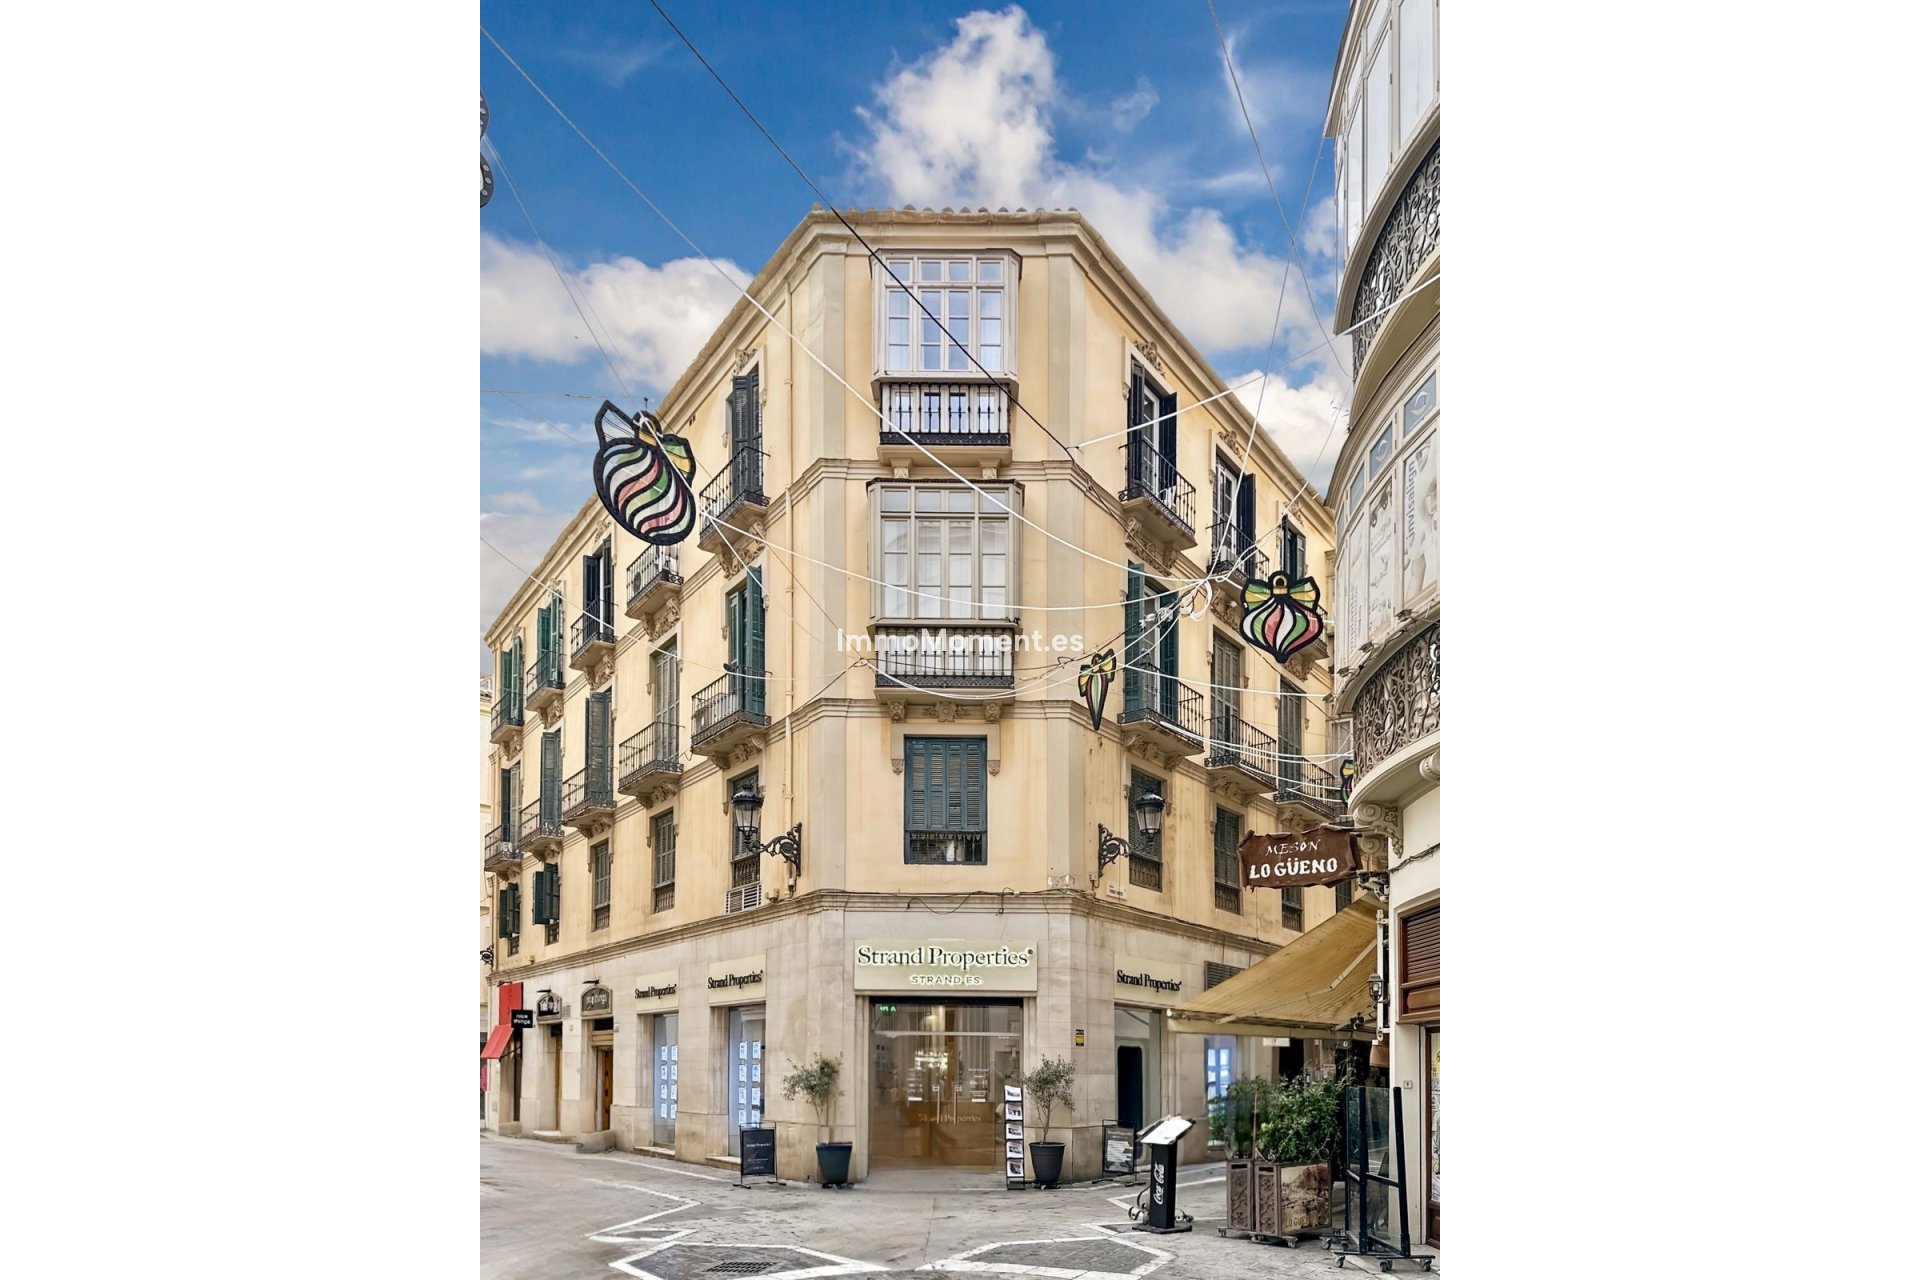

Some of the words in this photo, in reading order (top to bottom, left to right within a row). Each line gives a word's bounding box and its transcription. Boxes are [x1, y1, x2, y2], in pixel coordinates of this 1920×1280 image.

[1249, 863, 1271, 879] LO
[1274, 857, 1338, 877] GÜENO
[858, 946, 922, 965] Strand
[707, 975, 728, 989] Strand
[911, 975, 981, 985] STRAND.ES
[1116, 969, 1143, 986] Strand
